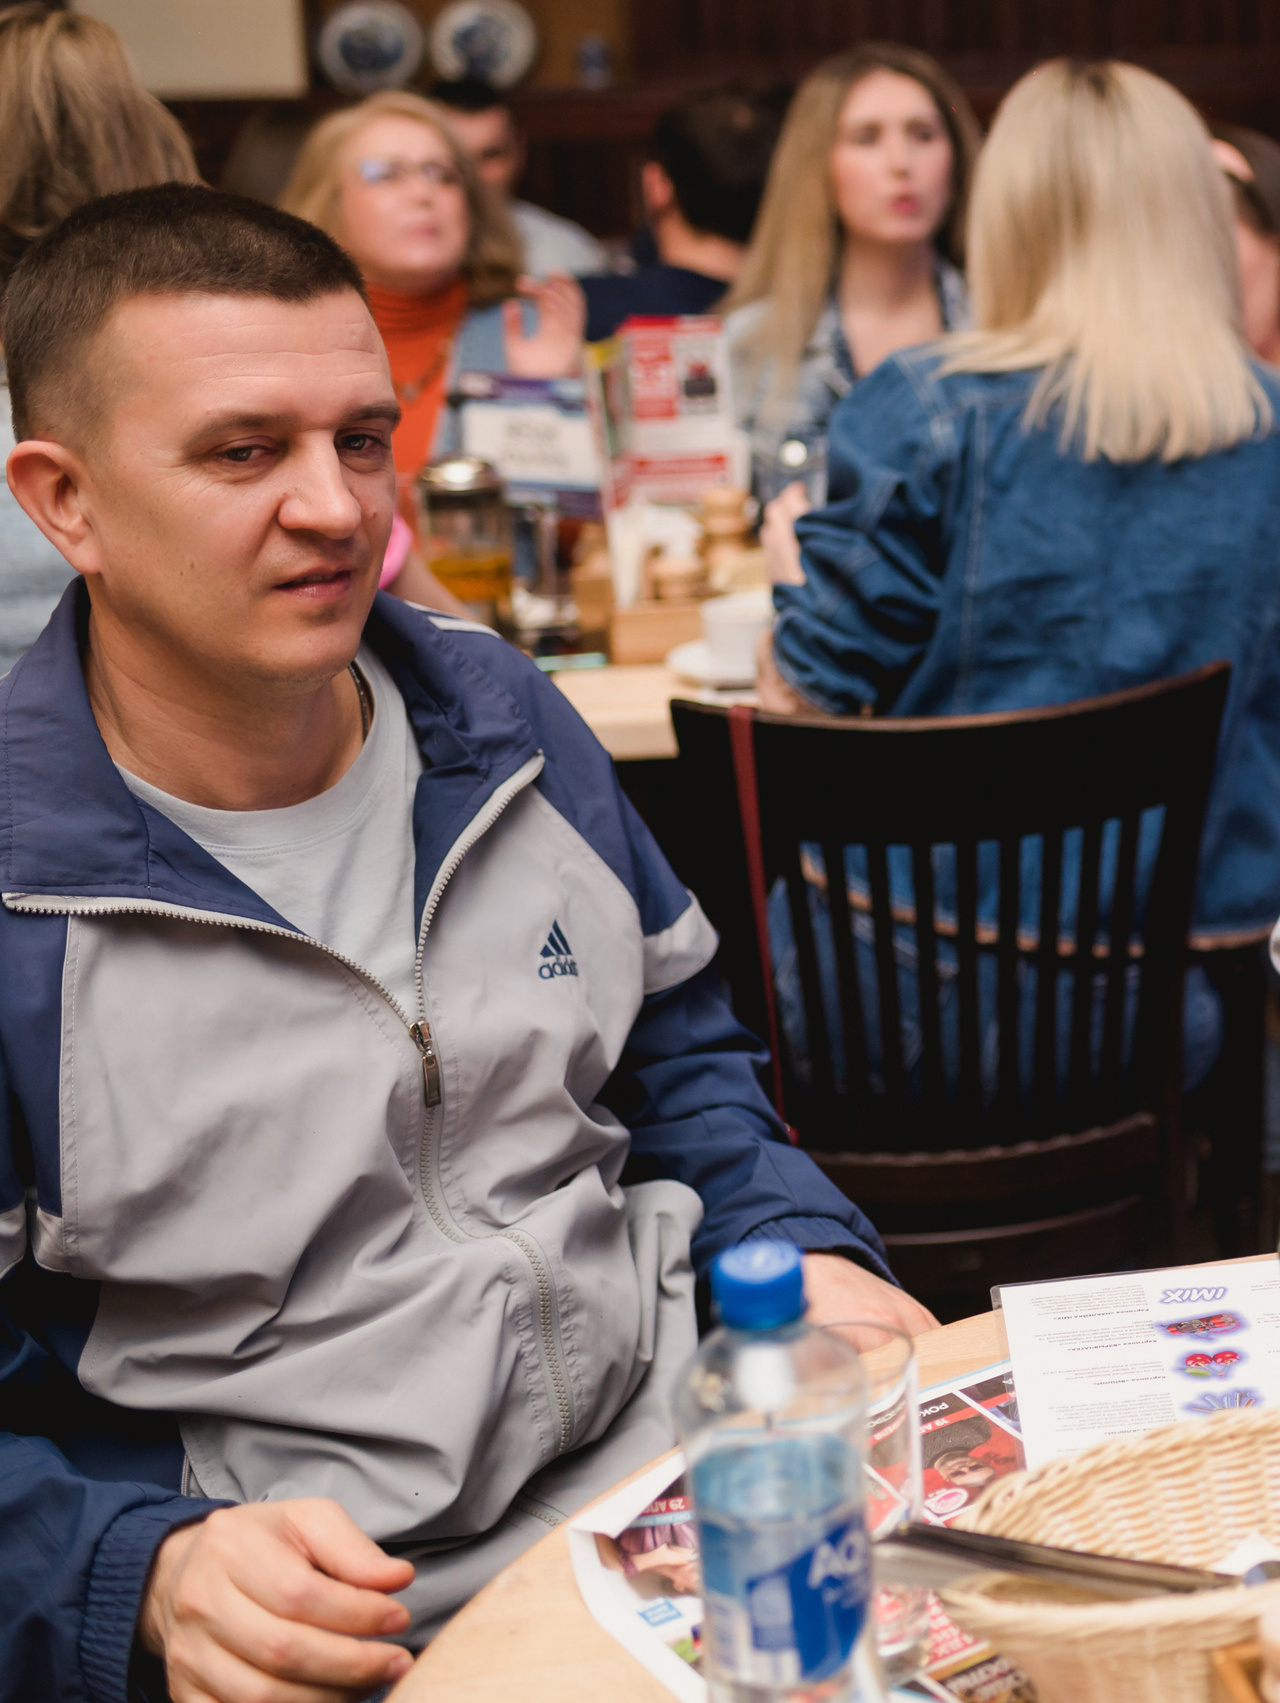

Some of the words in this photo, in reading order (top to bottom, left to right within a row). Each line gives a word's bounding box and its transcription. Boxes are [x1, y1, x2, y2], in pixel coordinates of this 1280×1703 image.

[538, 956, 579, 980] adid
[1162, 1287, 1224, 1304] IMIX
[934, 1417, 949, 1427] 19
[669, 1498, 685, 1511] 29
